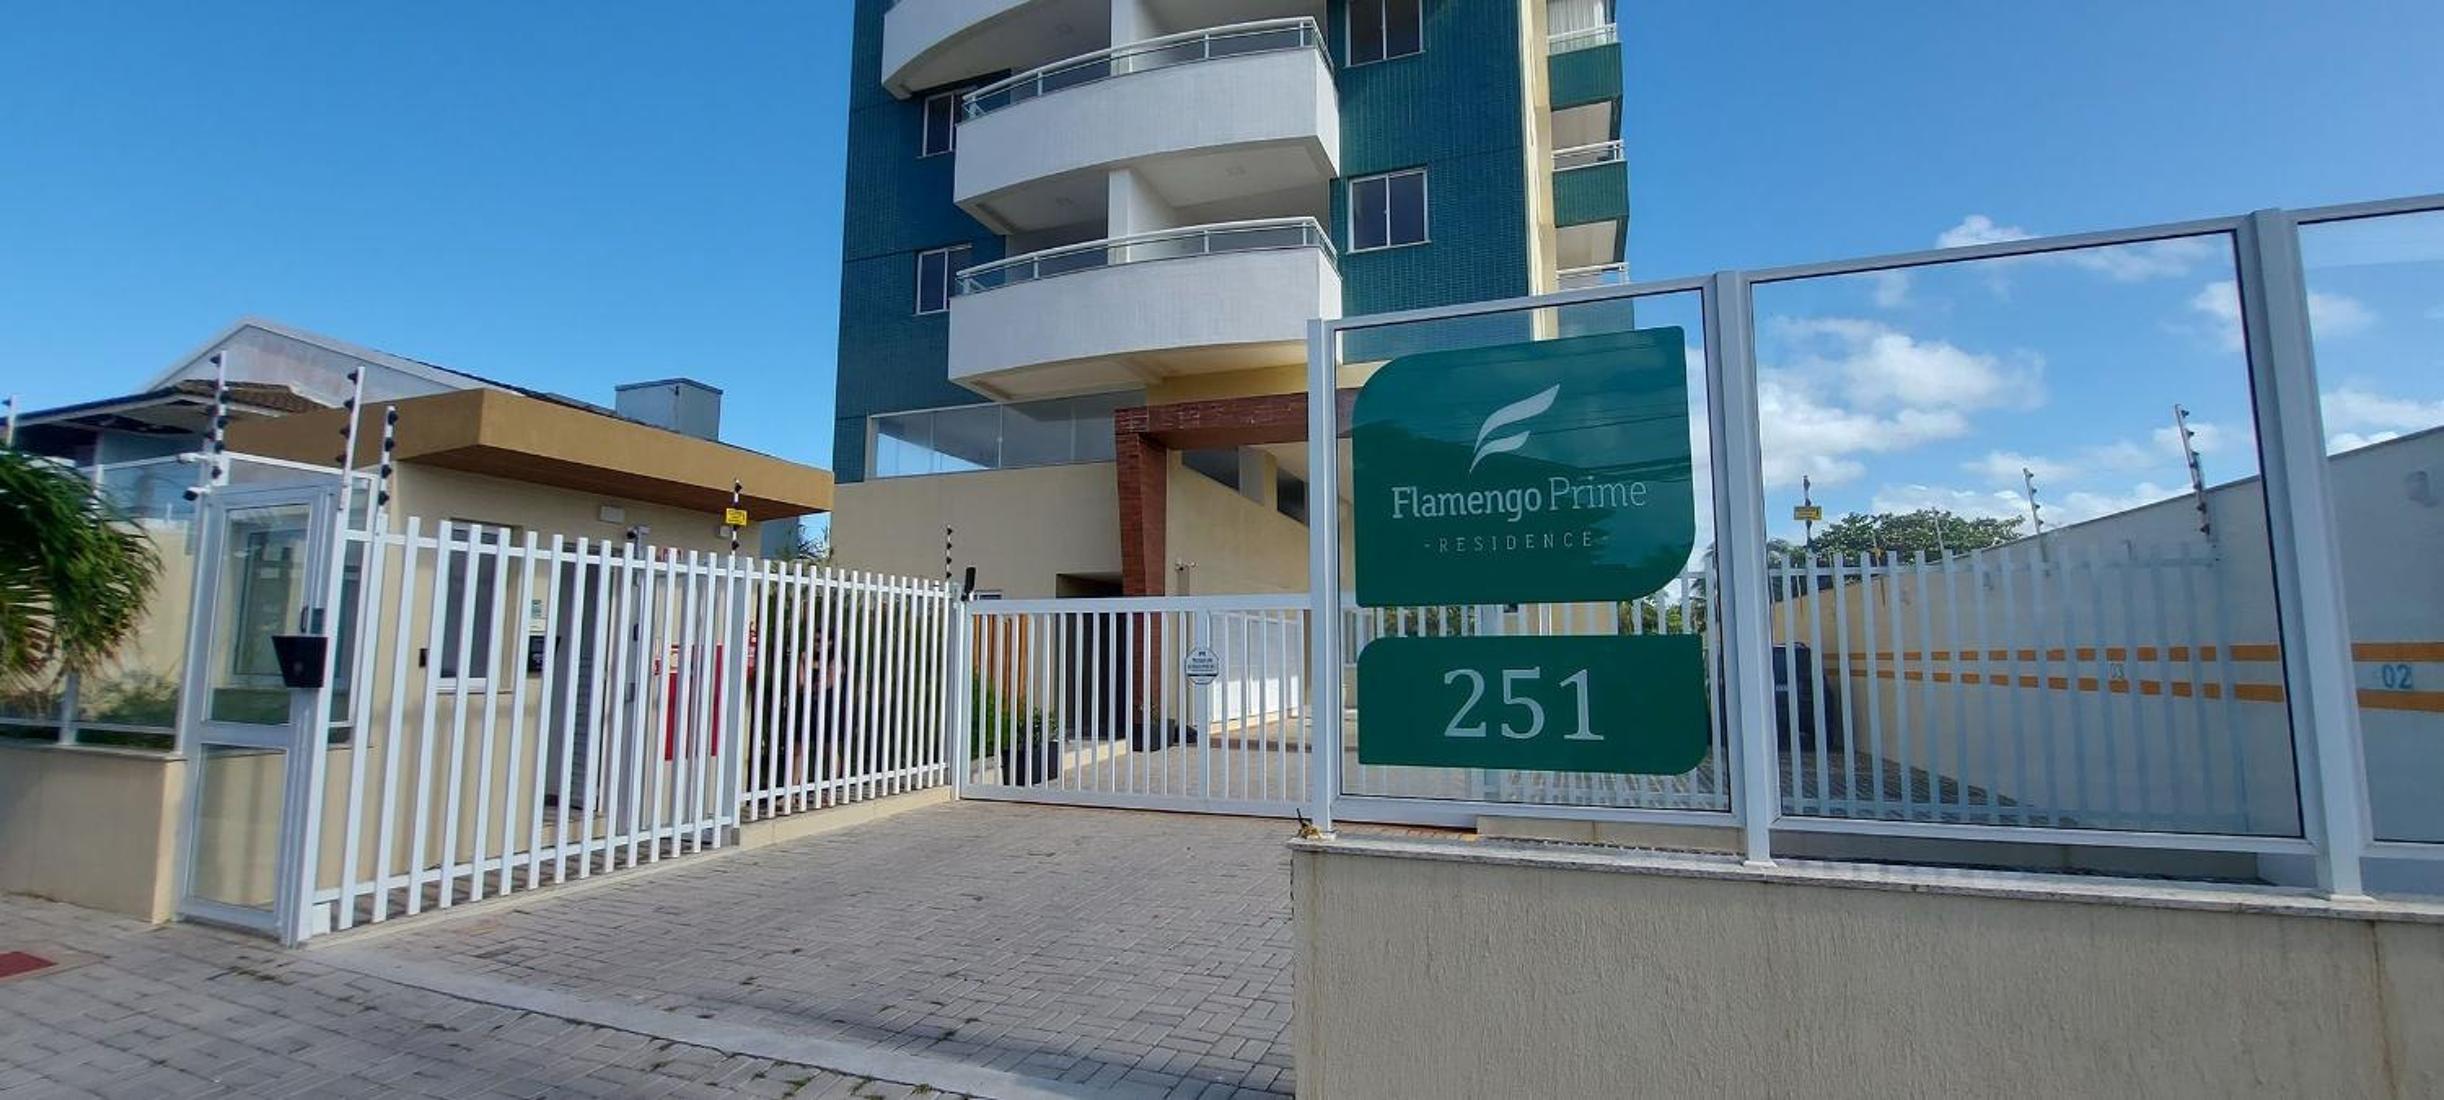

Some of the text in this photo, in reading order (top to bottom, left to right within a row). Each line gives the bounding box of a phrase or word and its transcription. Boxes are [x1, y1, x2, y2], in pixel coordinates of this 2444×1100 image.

[1391, 476, 1647, 522] Flamengo Prime
[2382, 663, 2412, 689] 02
[1444, 666, 1604, 741] 251
